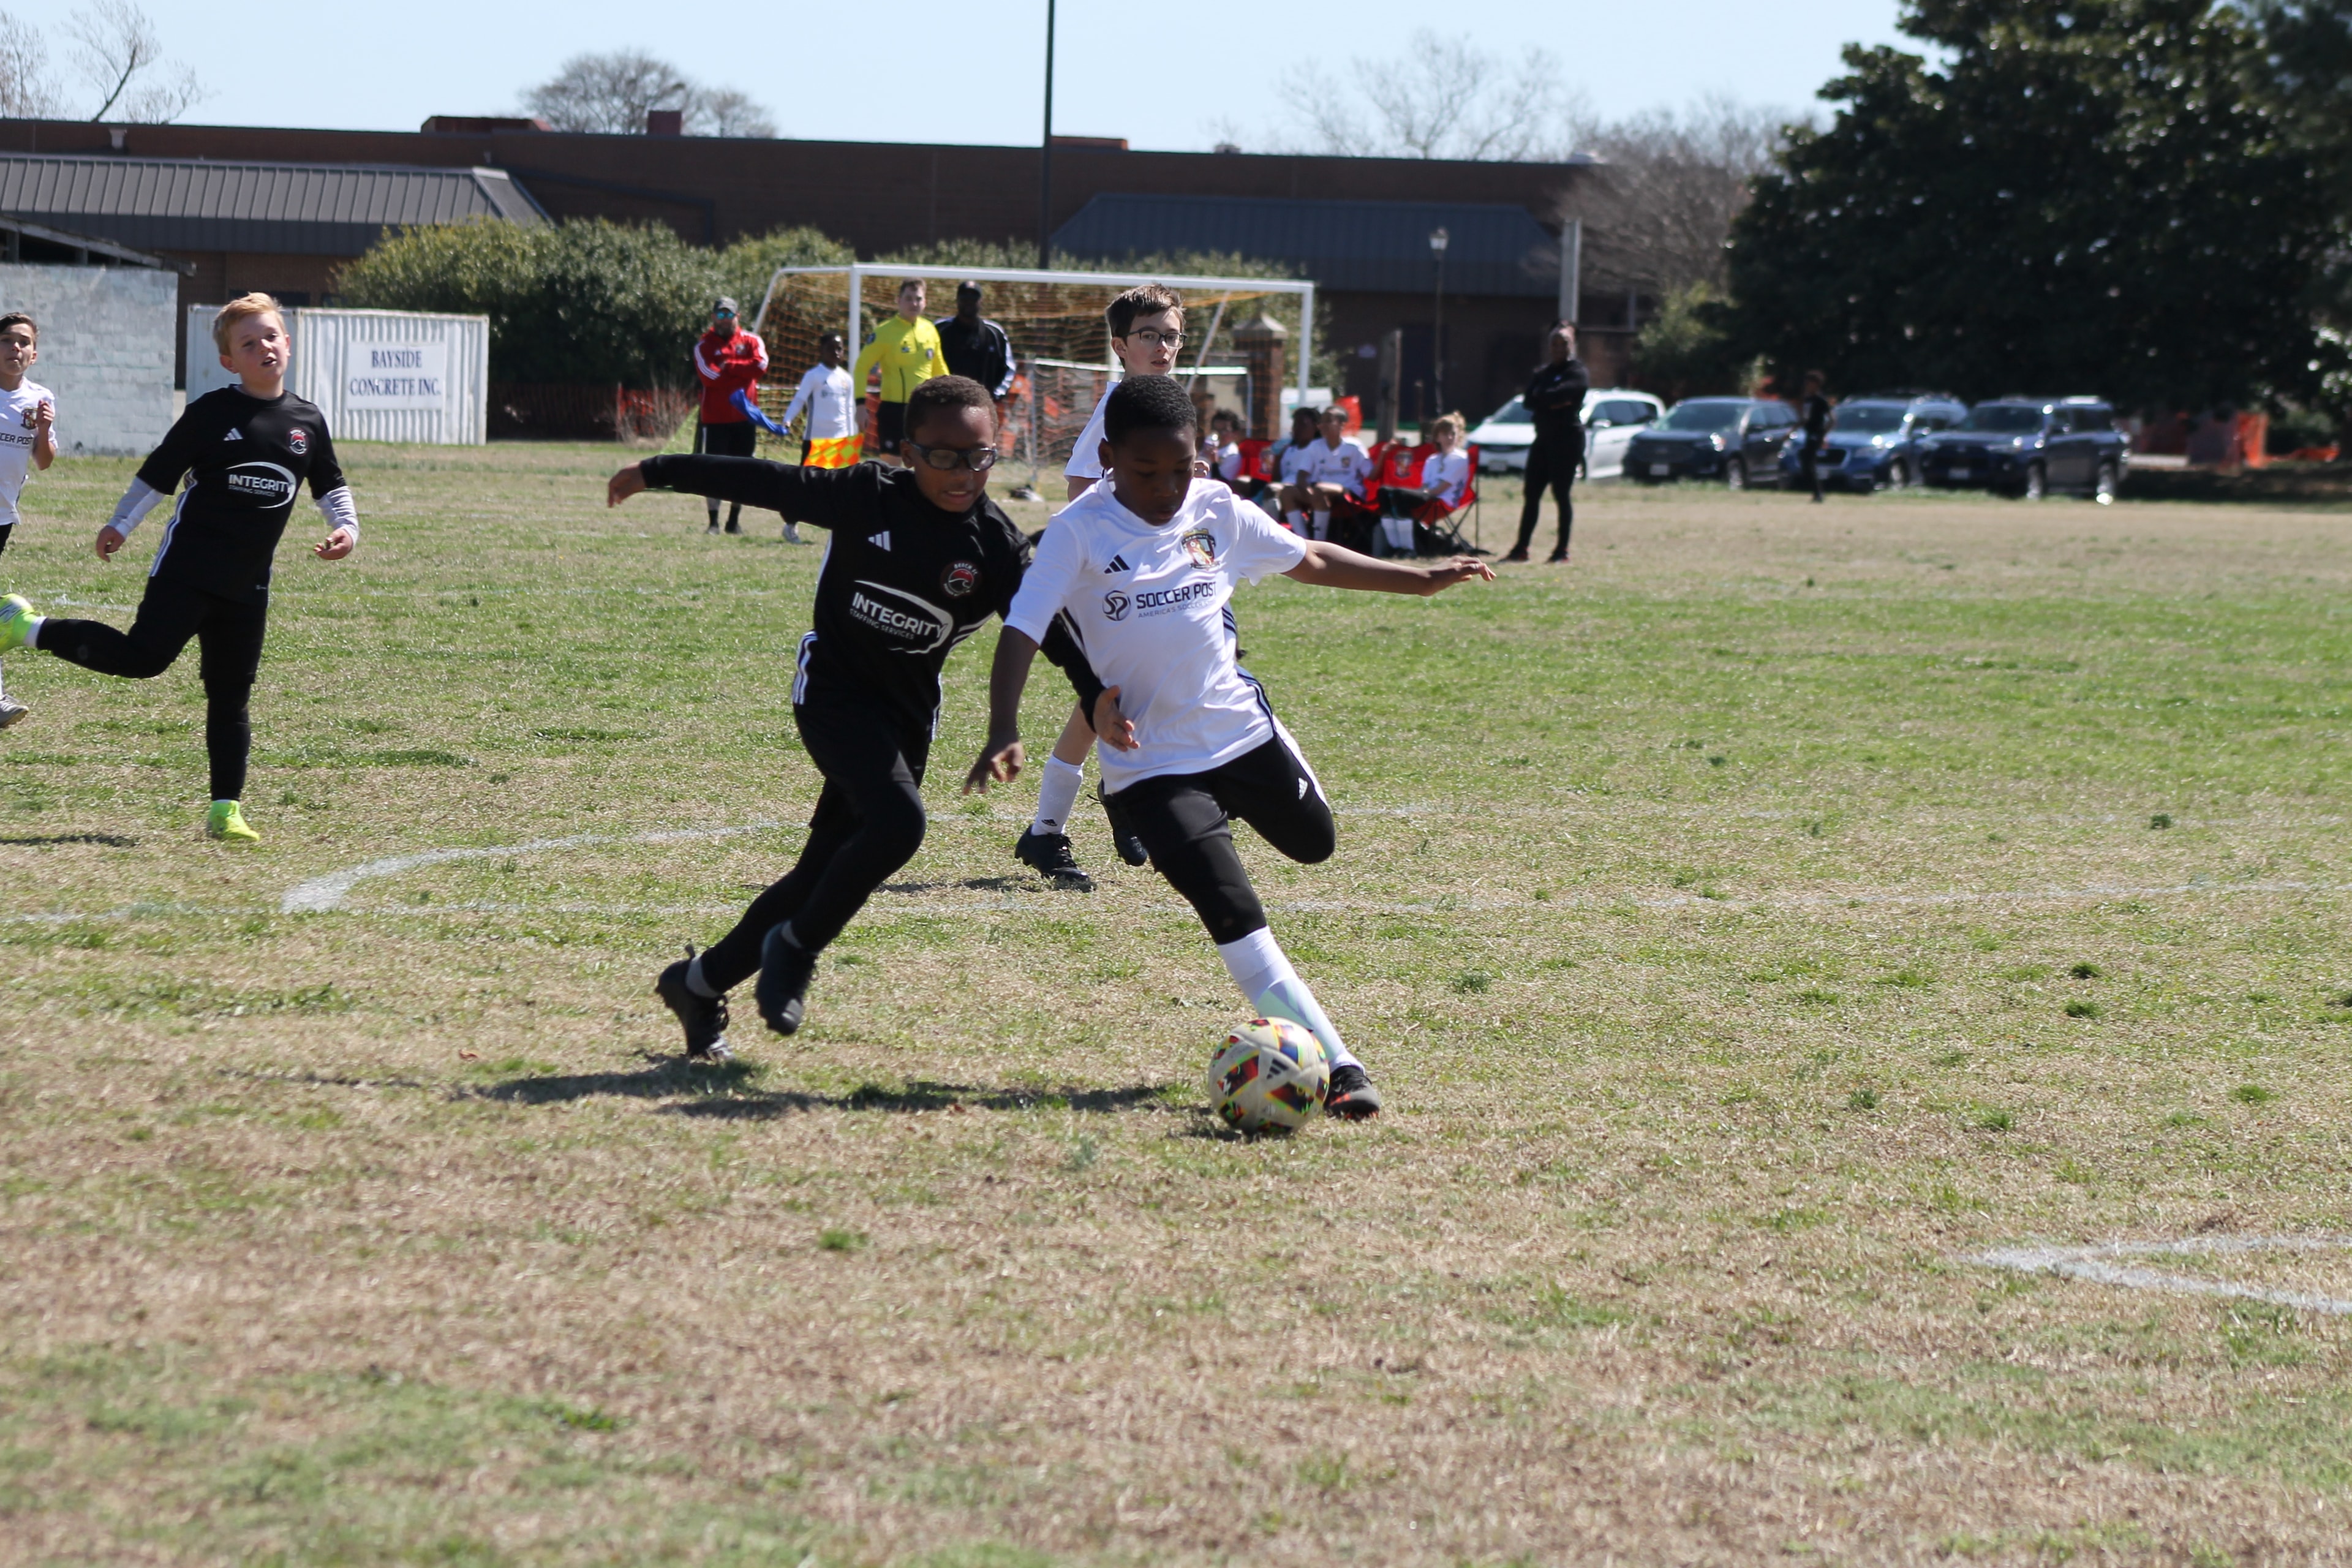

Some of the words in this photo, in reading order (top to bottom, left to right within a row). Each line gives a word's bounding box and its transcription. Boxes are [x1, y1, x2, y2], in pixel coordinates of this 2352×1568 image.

[371, 350, 422, 369] BAYSIDE
[350, 378, 417, 396] CONCRETE
[418, 378, 441, 396] INC.
[1136, 586, 1190, 609] SOCCER
[1194, 581, 1216, 599] POST
[849, 608, 879, 629] STAFFING
[880, 625, 914, 640] SERVICES
[852, 592, 948, 639] INTEGRITY
